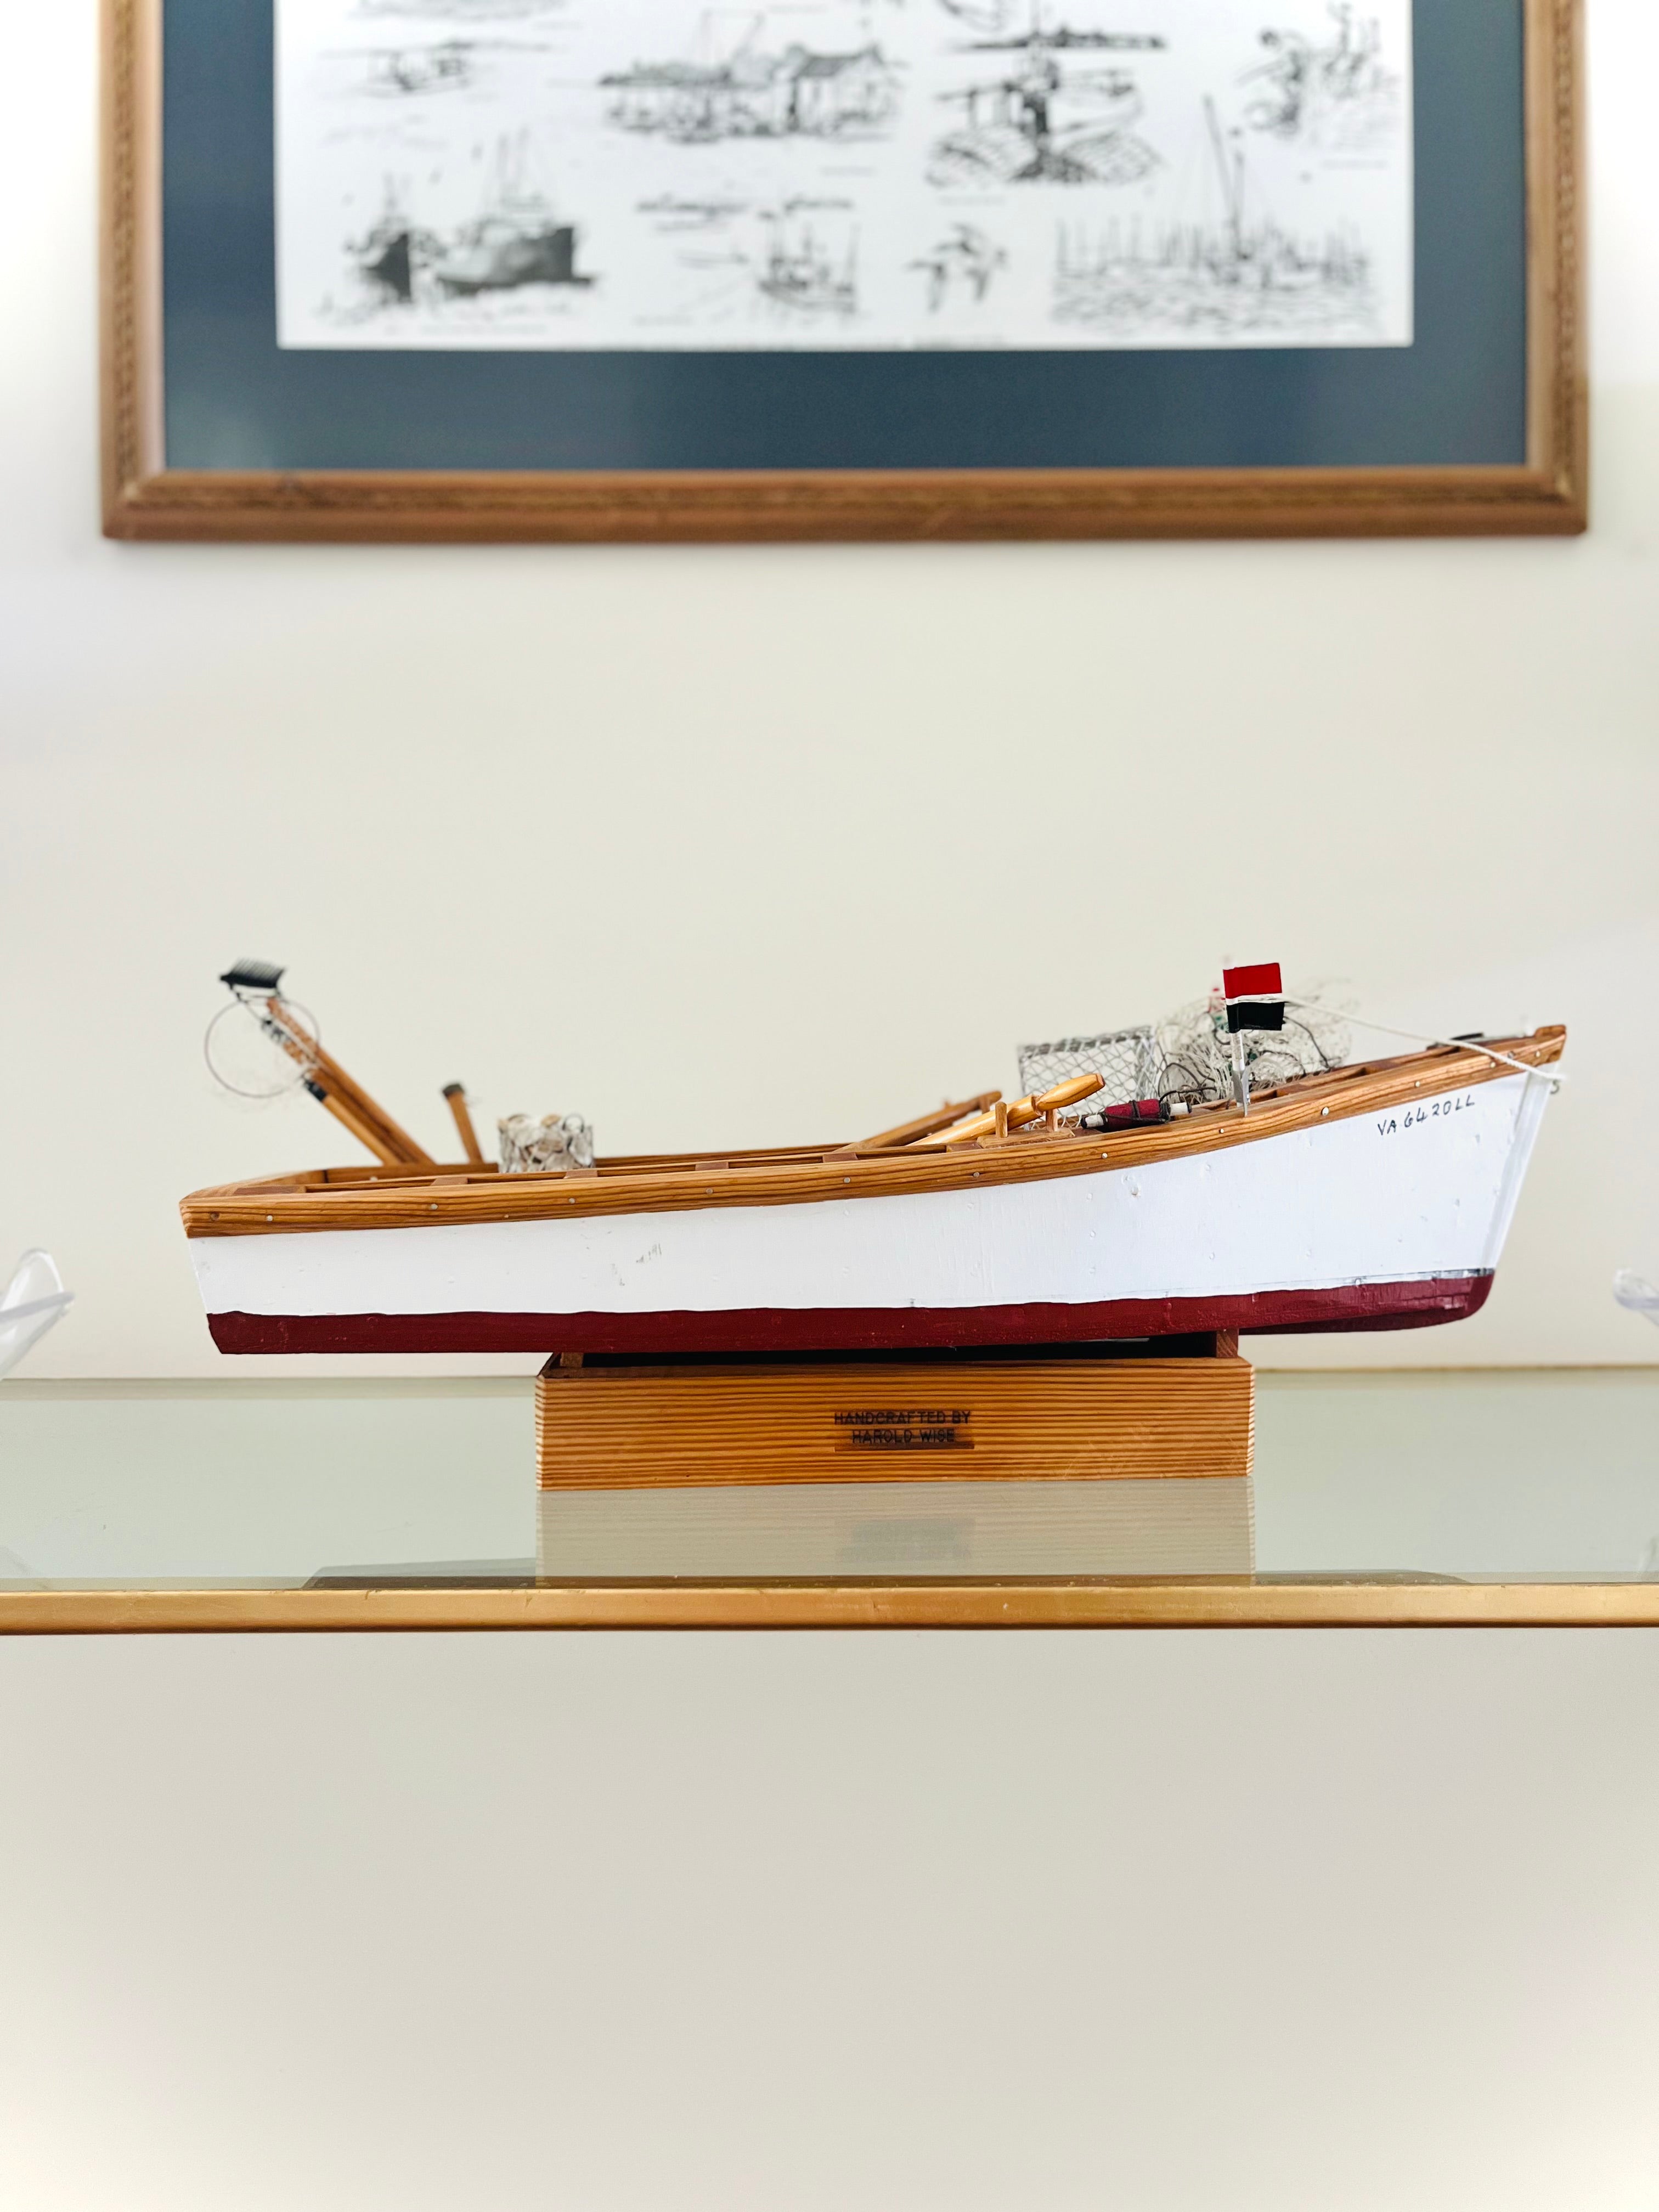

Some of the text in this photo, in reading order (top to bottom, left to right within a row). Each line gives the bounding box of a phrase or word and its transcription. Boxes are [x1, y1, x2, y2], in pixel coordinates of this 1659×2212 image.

[1377, 1120, 1397, 1136] VA
[834, 1410, 970, 1425] HANDCRAFTED BY
[852, 1429, 955, 1444] HAROLD WISE
